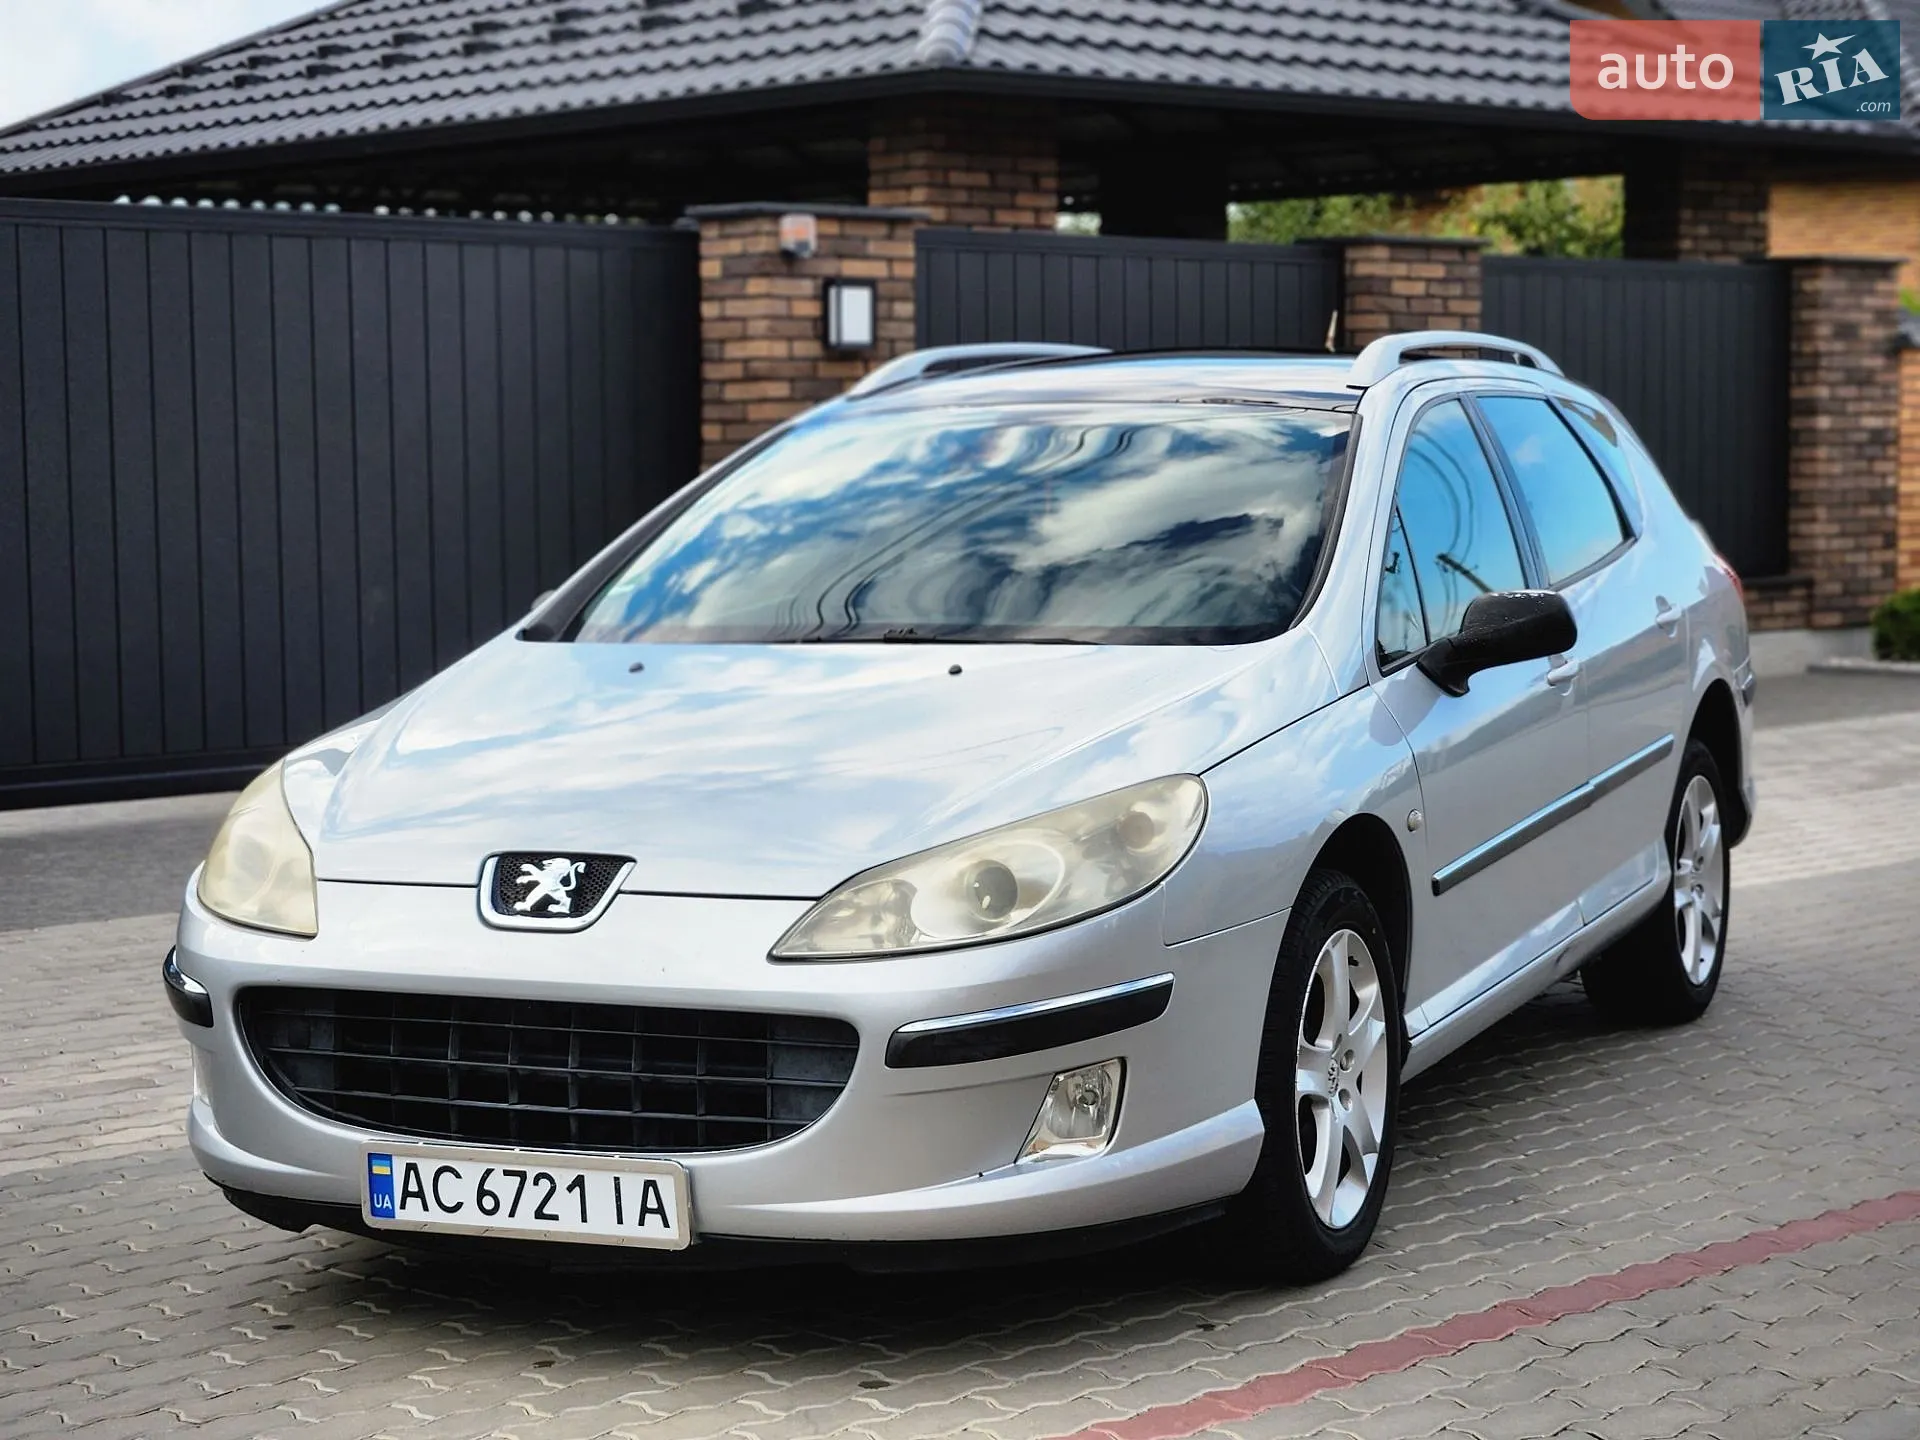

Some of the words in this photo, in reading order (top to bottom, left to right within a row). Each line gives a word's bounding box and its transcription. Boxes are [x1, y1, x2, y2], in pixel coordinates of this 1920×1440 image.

[374, 1193, 393, 1210] UA
[399, 1162, 464, 1214] AC
[476, 1167, 588, 1224] 6721
[613, 1175, 671, 1229] IA
